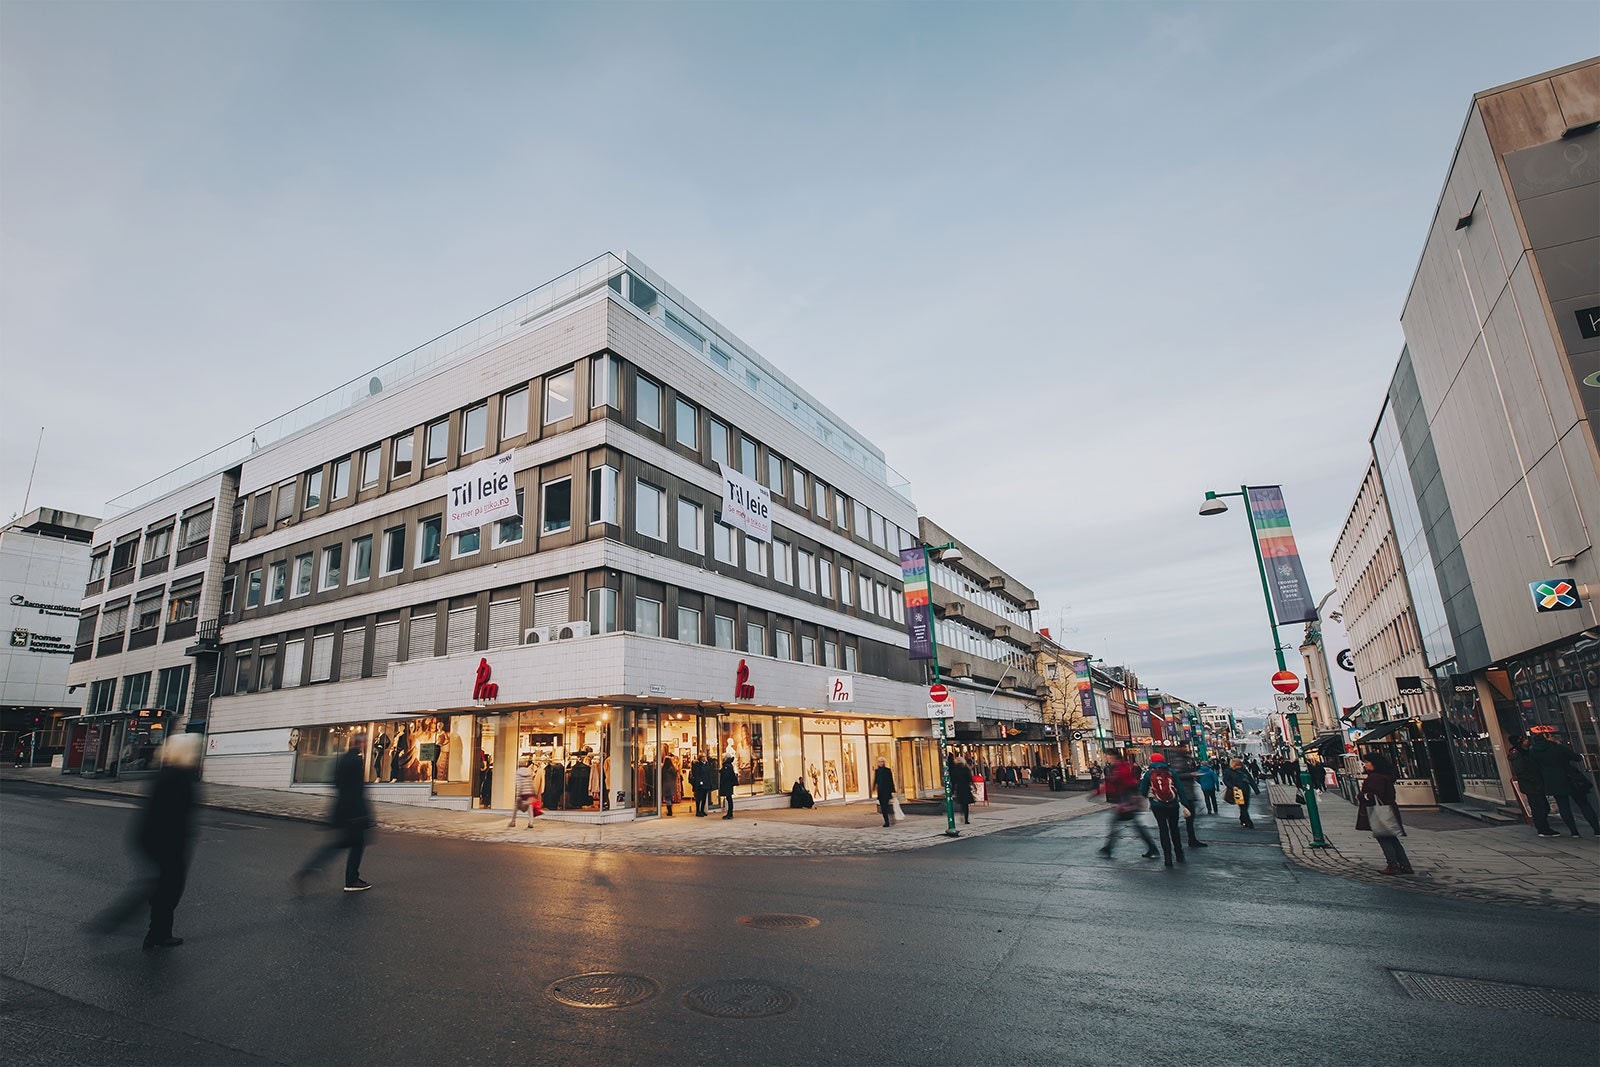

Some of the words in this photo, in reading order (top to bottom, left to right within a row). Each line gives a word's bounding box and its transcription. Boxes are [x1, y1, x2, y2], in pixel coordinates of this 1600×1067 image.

[452, 481, 471, 506] Til
[479, 472, 508, 500] leie
[727, 480, 743, 505] Til
[747, 491, 768, 518] leie
[30, 633, 61, 642] Tromsø
[30, 641, 71, 649] kommune
